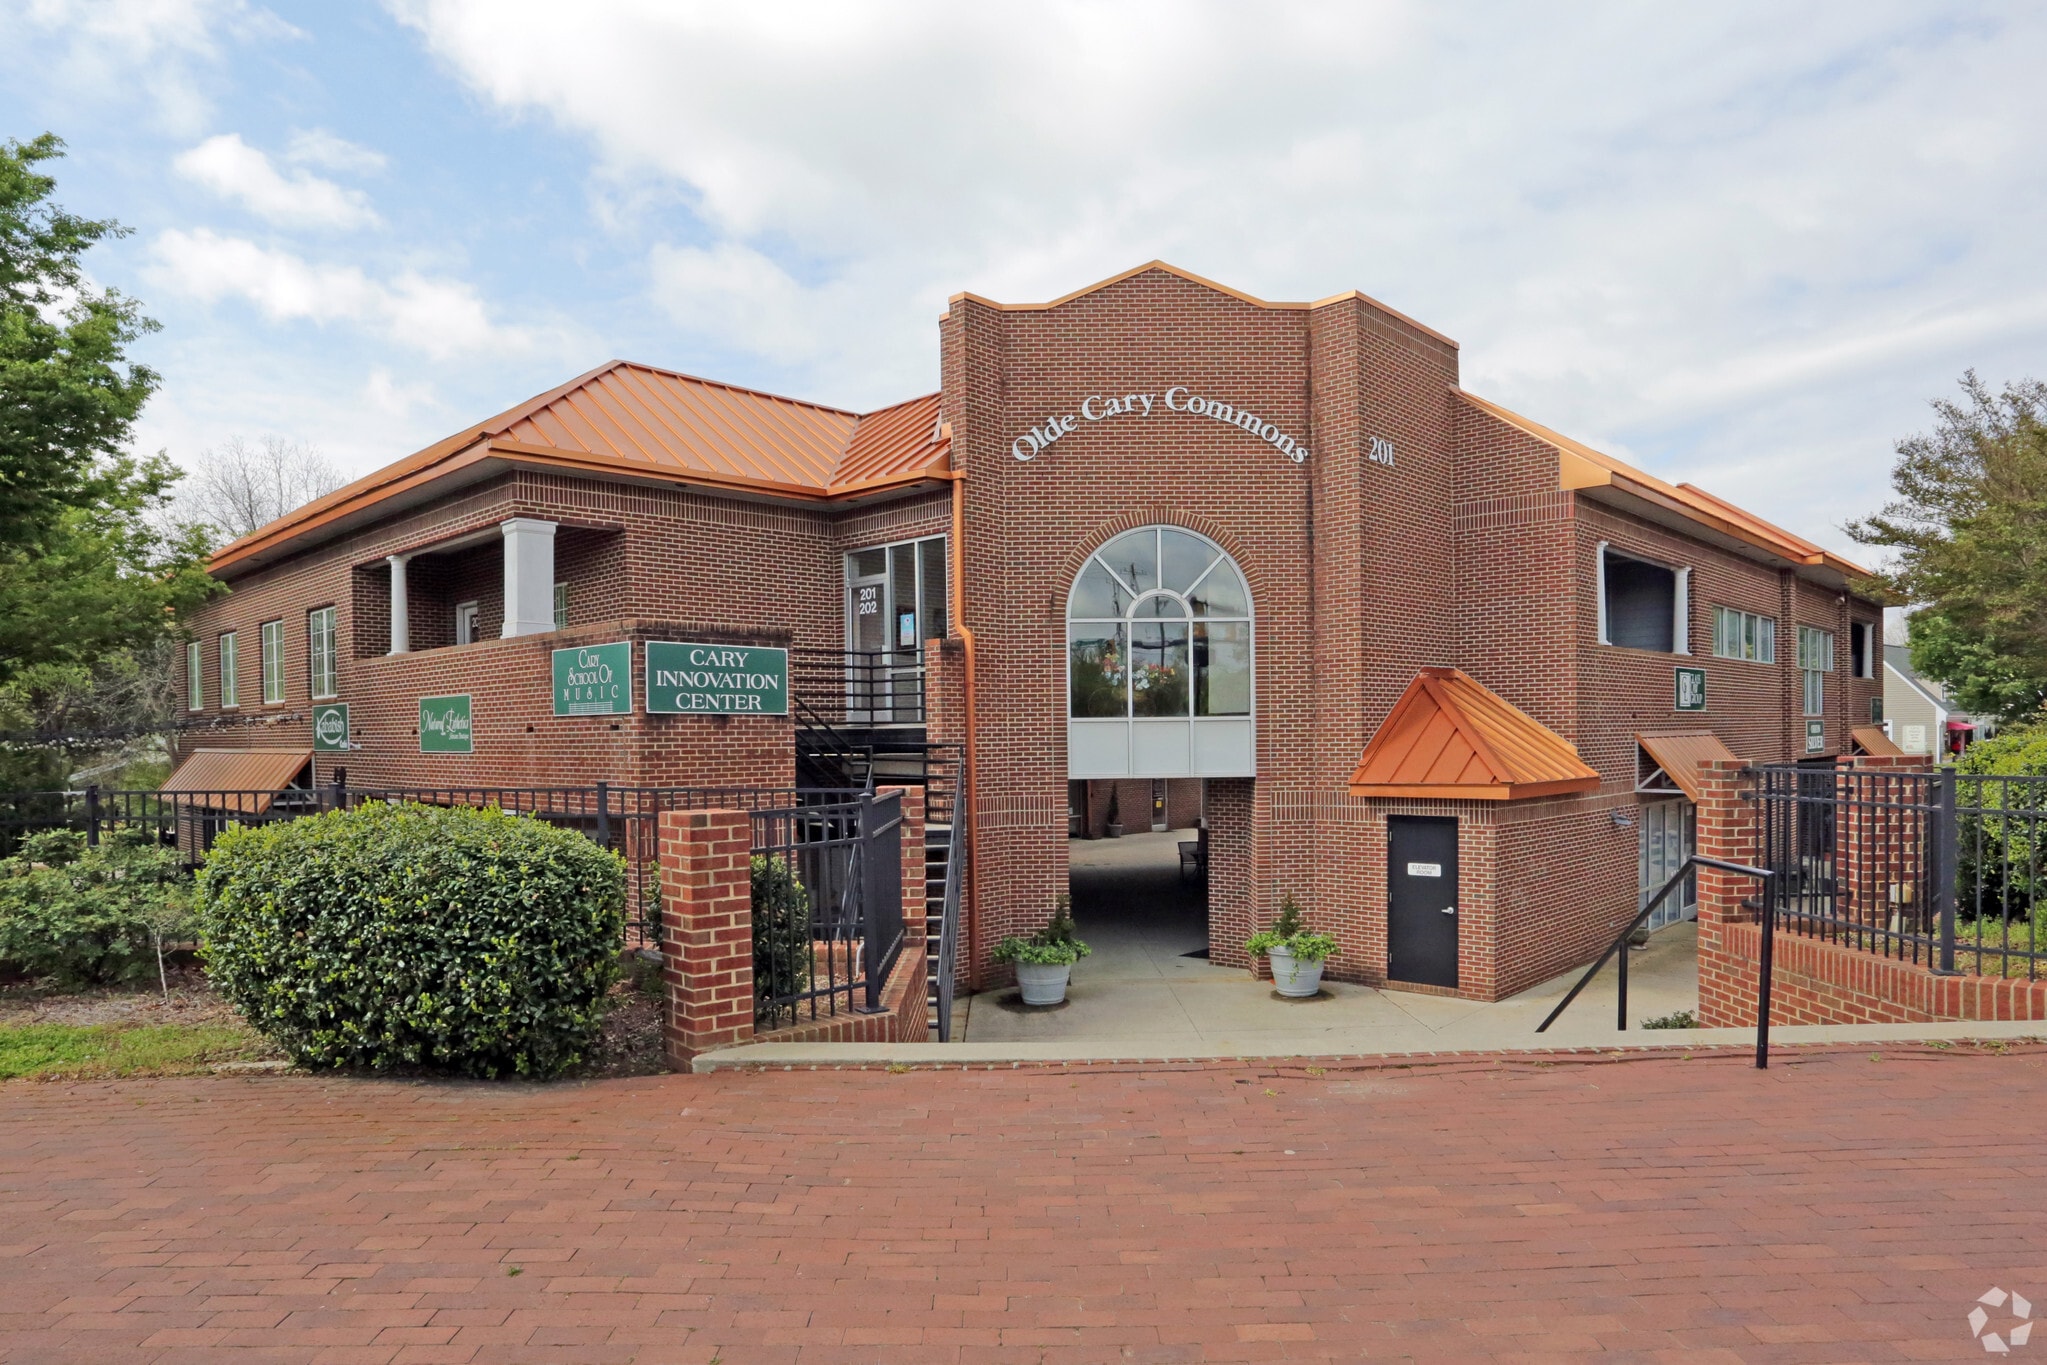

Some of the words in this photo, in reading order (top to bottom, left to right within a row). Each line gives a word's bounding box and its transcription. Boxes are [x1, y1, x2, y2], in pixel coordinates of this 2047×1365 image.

[1012, 415, 1078, 461] Olde
[1081, 393, 1157, 421] Cary
[1164, 386, 1309, 463] Commons
[1368, 436, 1394, 467] 201
[860, 587, 876, 601] 201
[859, 601, 877, 615] 202
[689, 649, 749, 668] CARY
[656, 670, 779, 690] INNOVATION
[675, 693, 762, 710] CENTER
